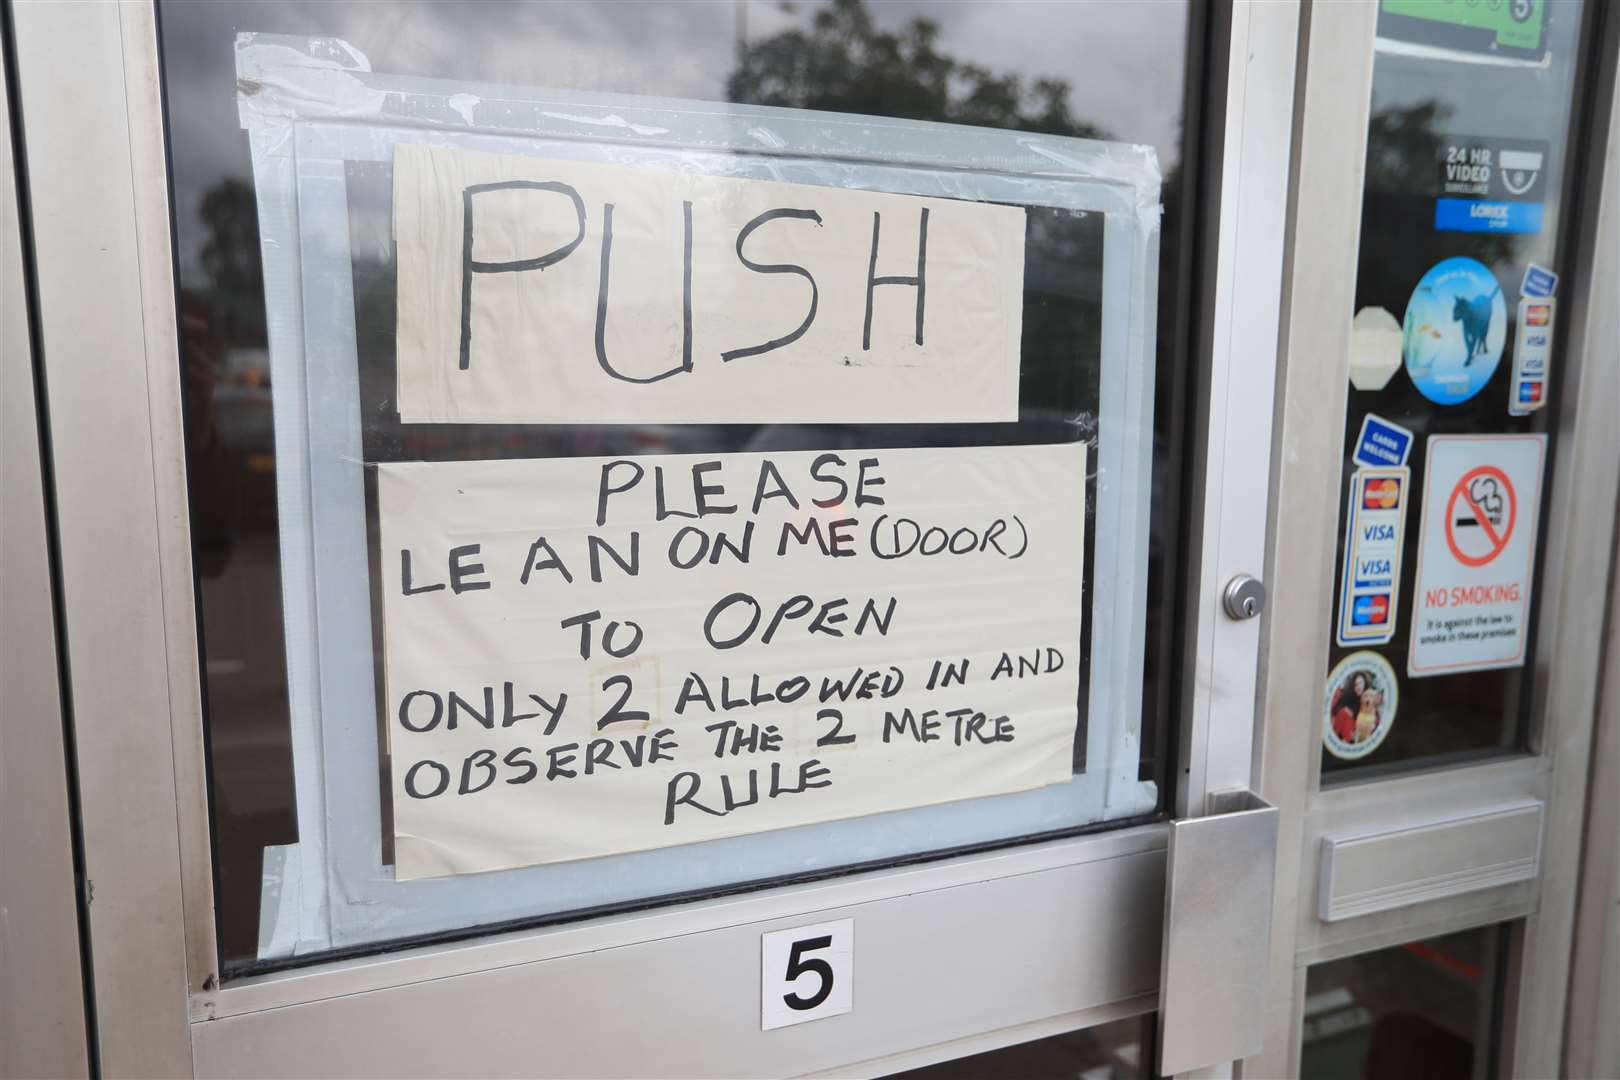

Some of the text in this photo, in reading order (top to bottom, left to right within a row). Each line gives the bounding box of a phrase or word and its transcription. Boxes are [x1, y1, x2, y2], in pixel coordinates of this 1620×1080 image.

[1446, 164, 1490, 182] VIDEO
[1447, 146, 1492, 164] 24 HR
[459, 180, 929, 383] PUSH
[597, 454, 885, 526] PLEASE
[401, 532, 639, 595] LEAN
[669, 521, 754, 569] ON
[1364, 524, 1395, 542] VISA
[1361, 560, 1391, 576] VISA
[1424, 587, 1448, 609] NO
[561, 593, 896, 660] TO OPEN
[1420, 634, 1447, 645] smoke
[1458, 630, 1480, 640] these
[1481, 628, 1517, 641] premises
[1444, 617, 1473, 632] against
[1475, 615, 1489, 625] the
[1491, 615, 1503, 624] law
[1504, 614, 1513, 624] to
[399, 648, 1063, 735] ONLY 2 ALLOWED IN AND
[405, 709, 1014, 799] OBSERVE THE 2 METRE
[665, 760, 832, 825] RULE
[783, 935, 834, 1011] 5
